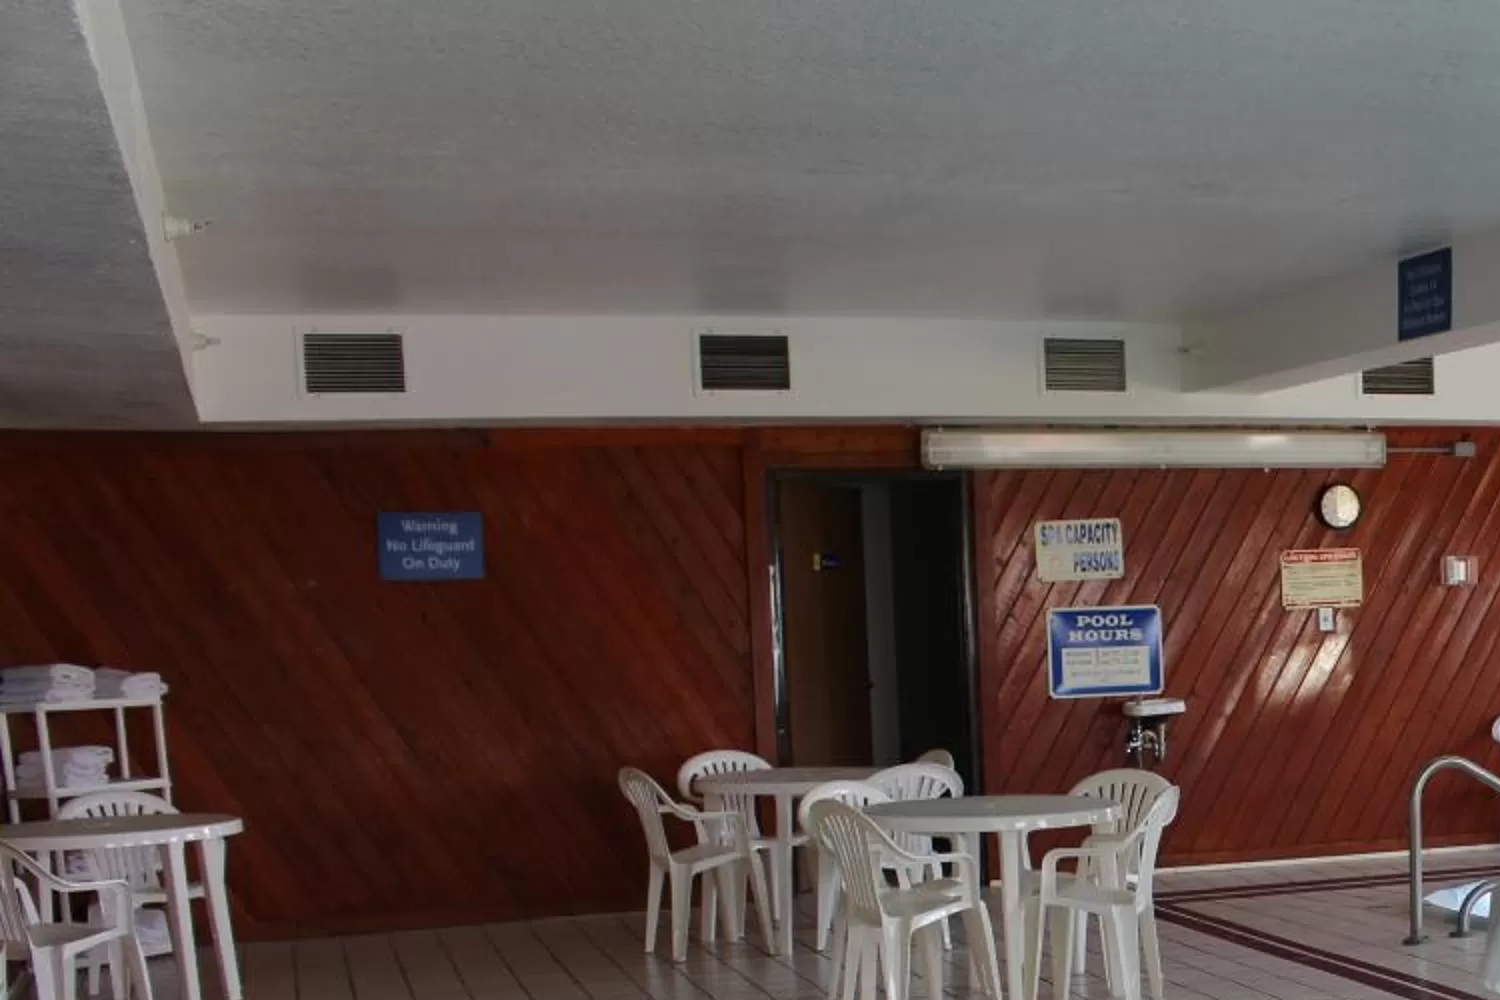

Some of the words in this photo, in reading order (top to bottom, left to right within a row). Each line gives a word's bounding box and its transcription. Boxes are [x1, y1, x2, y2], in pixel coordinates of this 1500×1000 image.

[401, 518, 458, 536] Warning
[1065, 523, 1119, 545] CAPACITY
[386, 538, 407, 552] No
[412, 537, 475, 555] Lifeguard
[402, 557, 425, 569] On
[428, 556, 459, 573] Duty
[1073, 551, 1120, 573] PERSONS
[1076, 614, 1133, 628] POOL
[1068, 628, 1143, 642] HOURS
